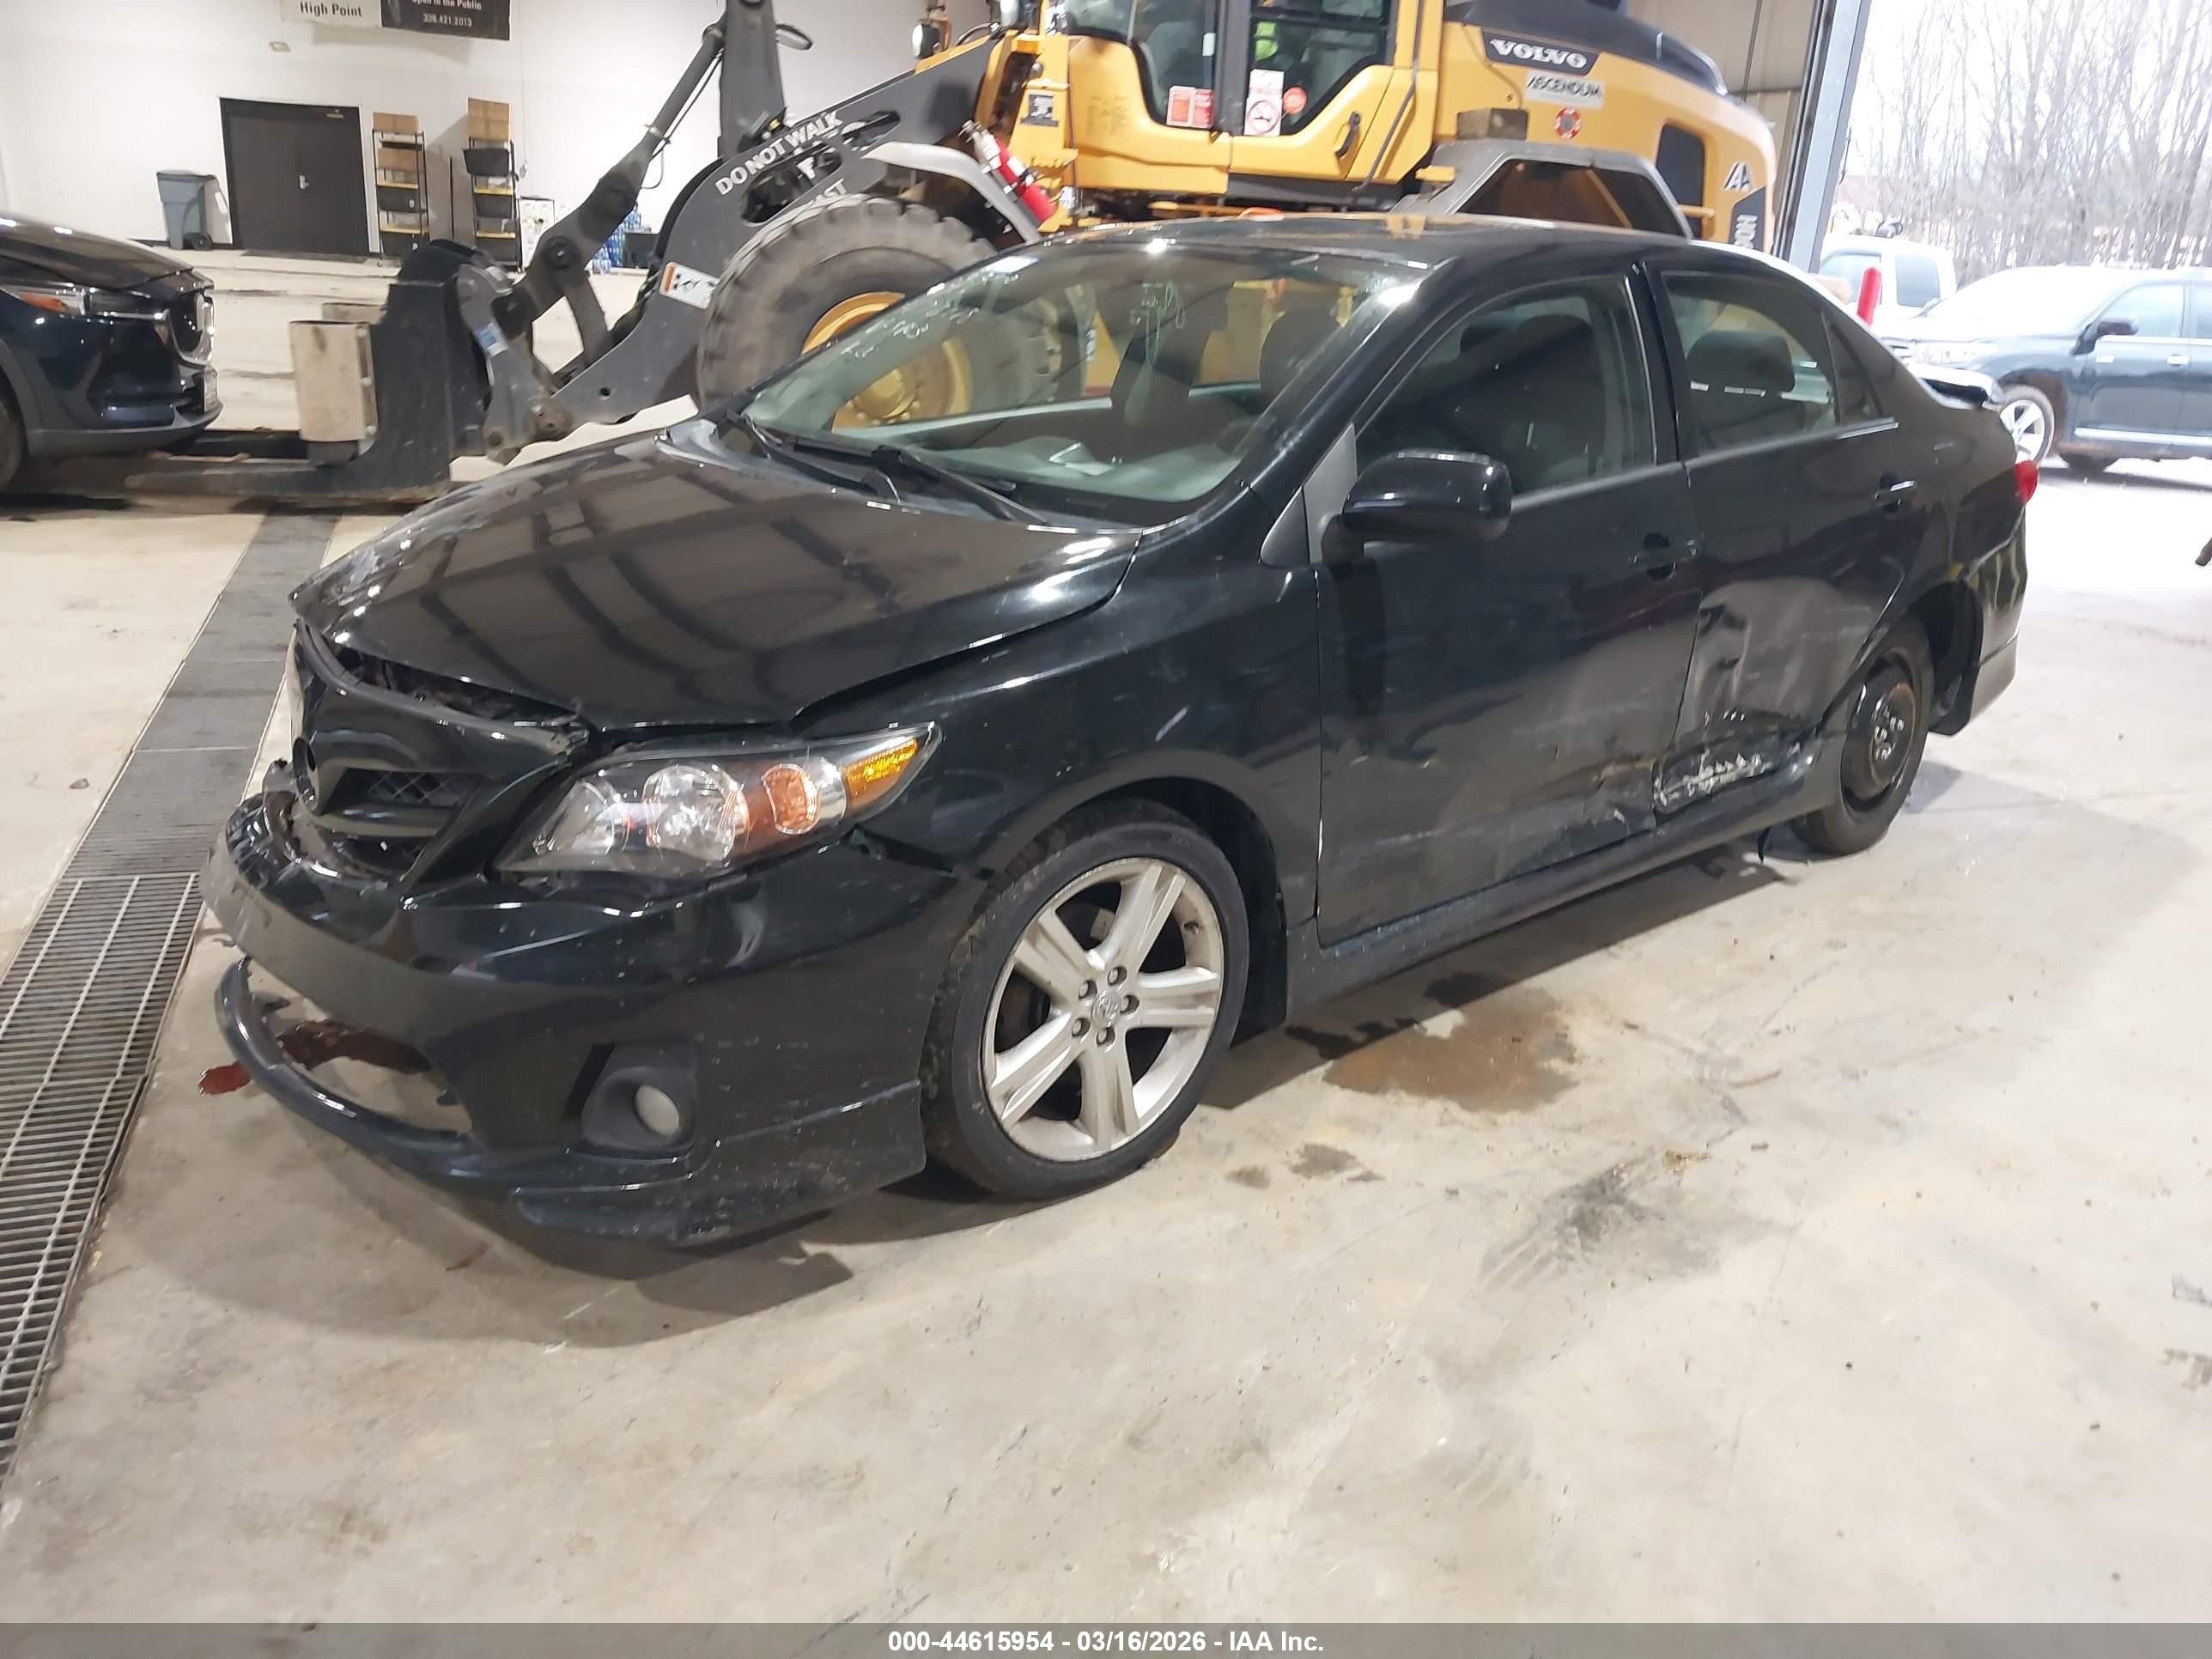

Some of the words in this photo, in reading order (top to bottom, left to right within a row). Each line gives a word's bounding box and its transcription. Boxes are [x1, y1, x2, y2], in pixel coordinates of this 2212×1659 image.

[300, 1, 327, 17] High
[331, 3, 362, 17] Point
[457, 0, 482, 10] Public
[1490, 39, 1588, 69] VOLVO
[1526, 75, 1601, 99] ASCENDUM
[714, 167, 748, 195] DO
[744, 137, 787, 175] NOT
[784, 110, 843, 149] WALK
